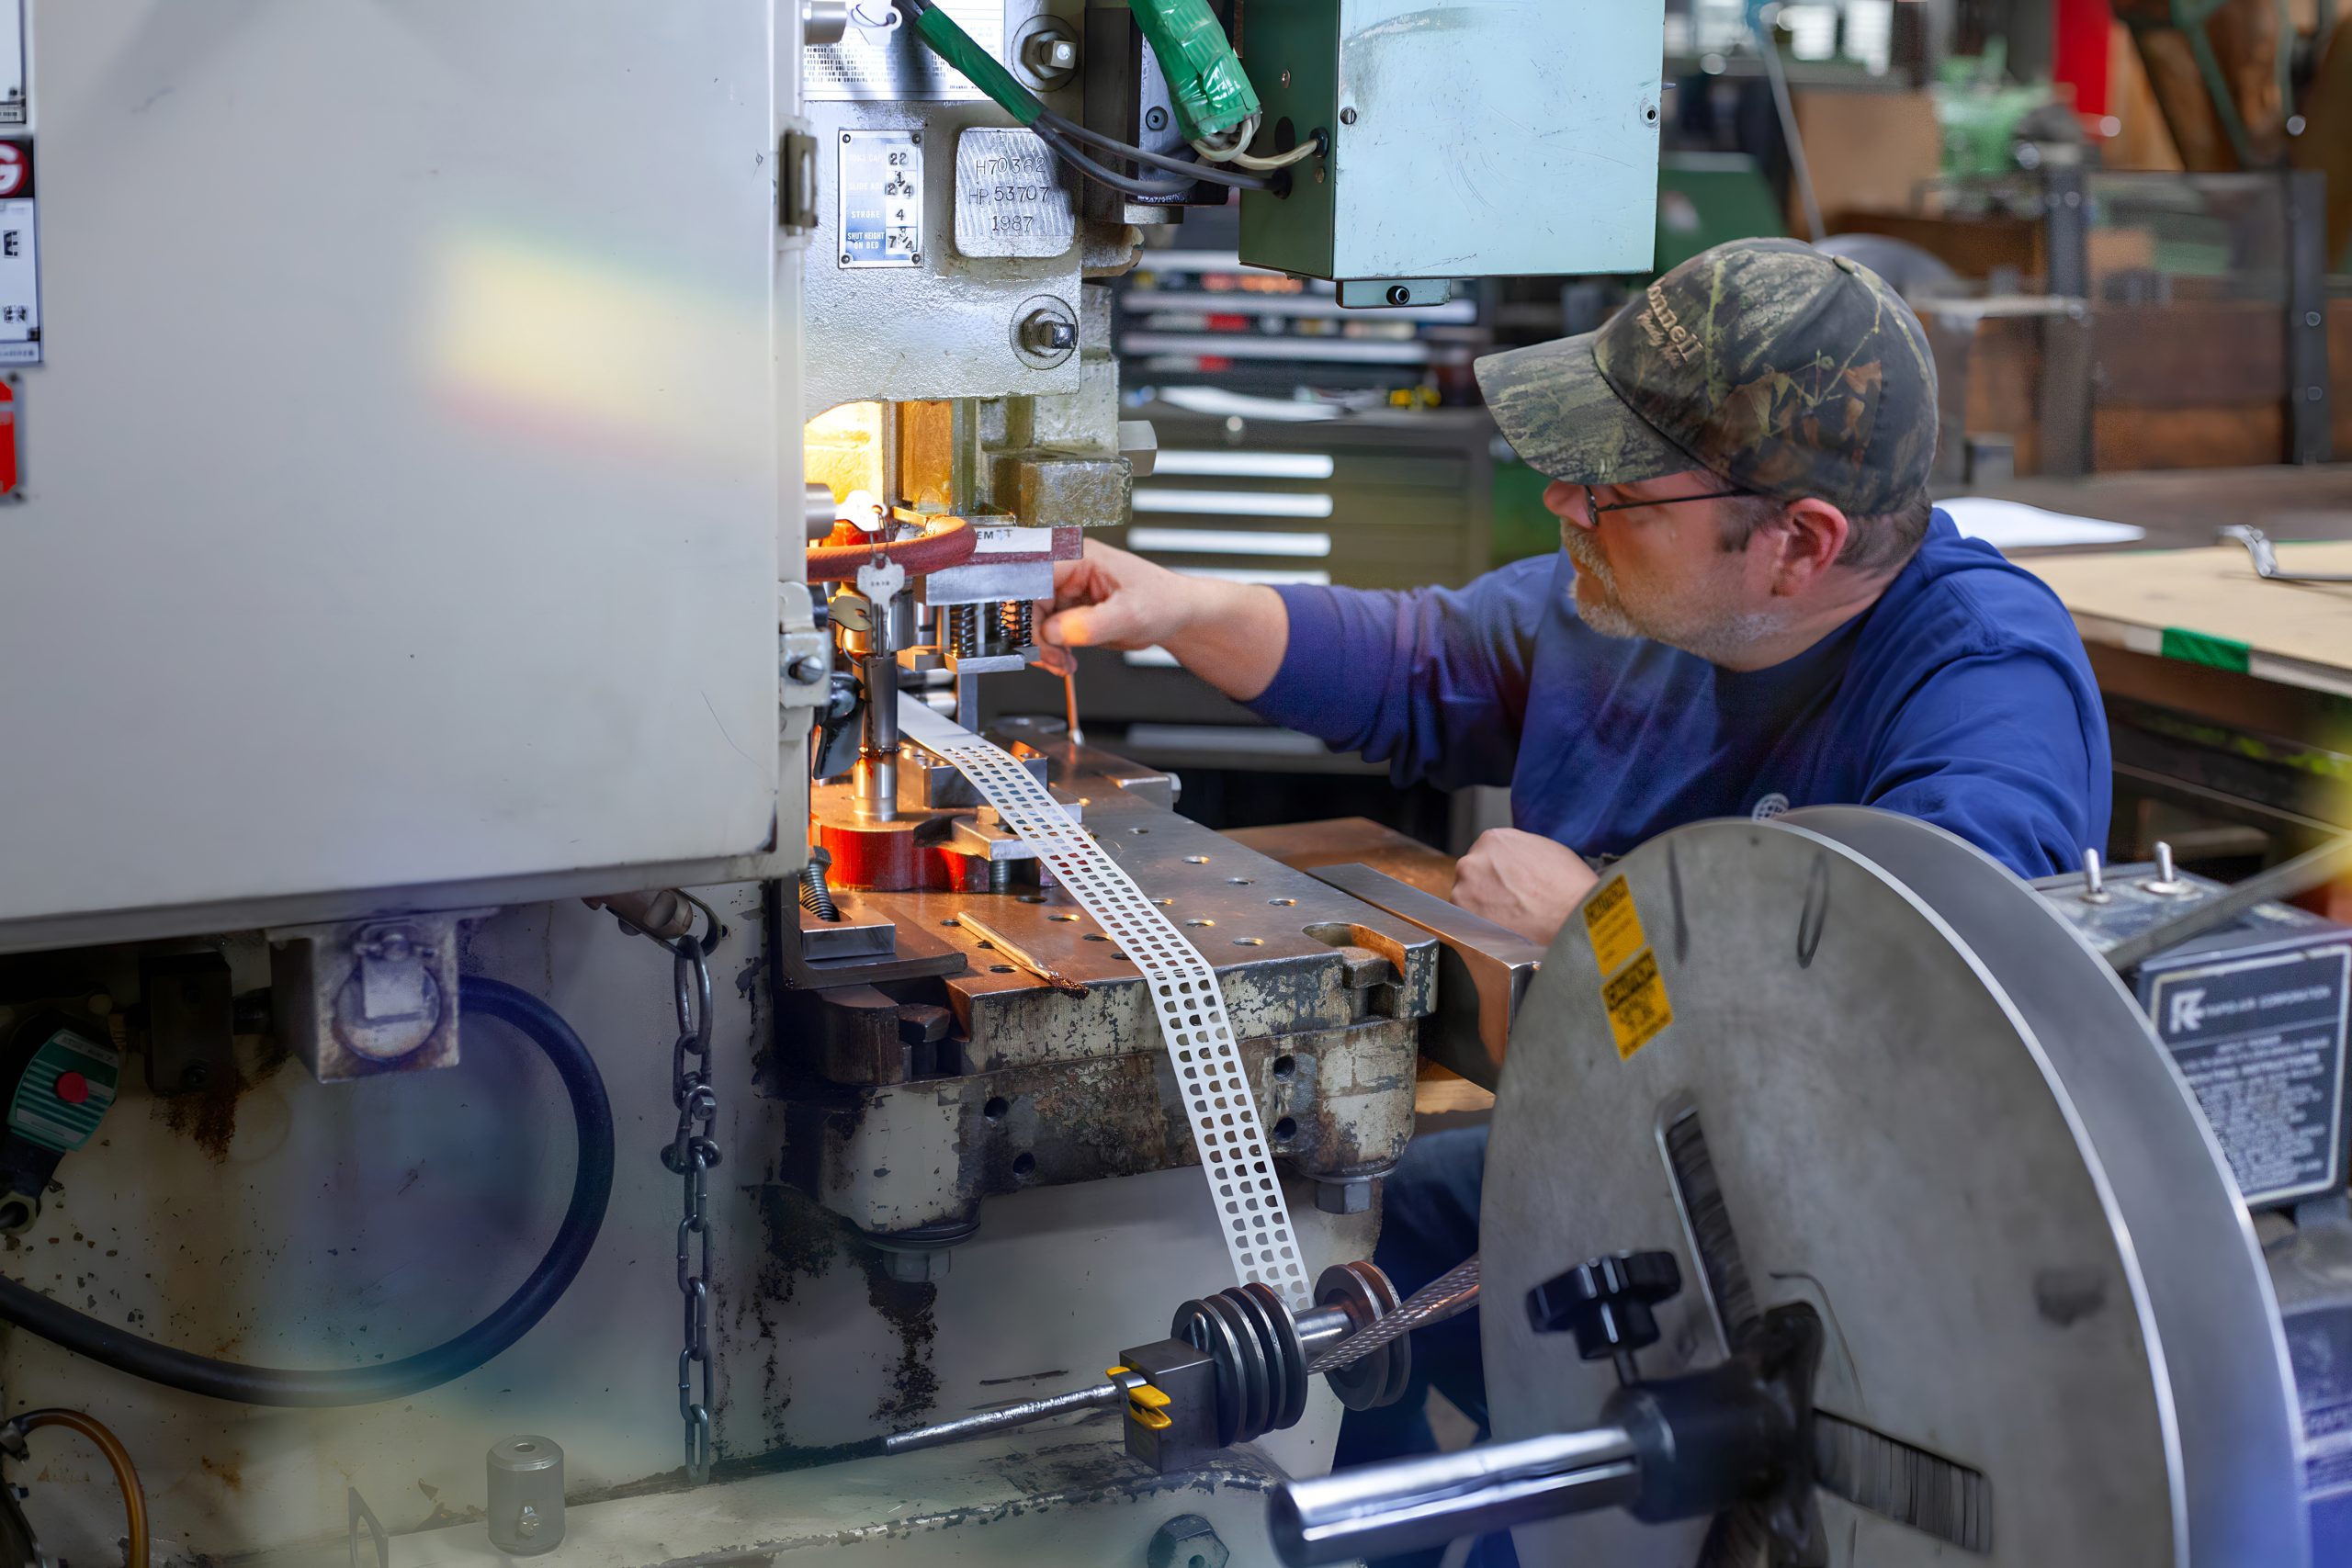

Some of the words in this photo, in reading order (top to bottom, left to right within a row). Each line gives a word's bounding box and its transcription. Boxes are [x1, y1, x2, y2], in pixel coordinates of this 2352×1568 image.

[888, 152, 907, 166] 22
[976, 157, 1046, 176] H70362
[851, 210, 881, 220] STROKE
[896, 209, 904, 221] 4
[992, 215, 1034, 231] 1987
[847, 231, 864, 241] SHUT
[865, 231, 885, 241] HEIGHT
[854, 242, 864, 250] ON
[865, 242, 879, 250] BED
